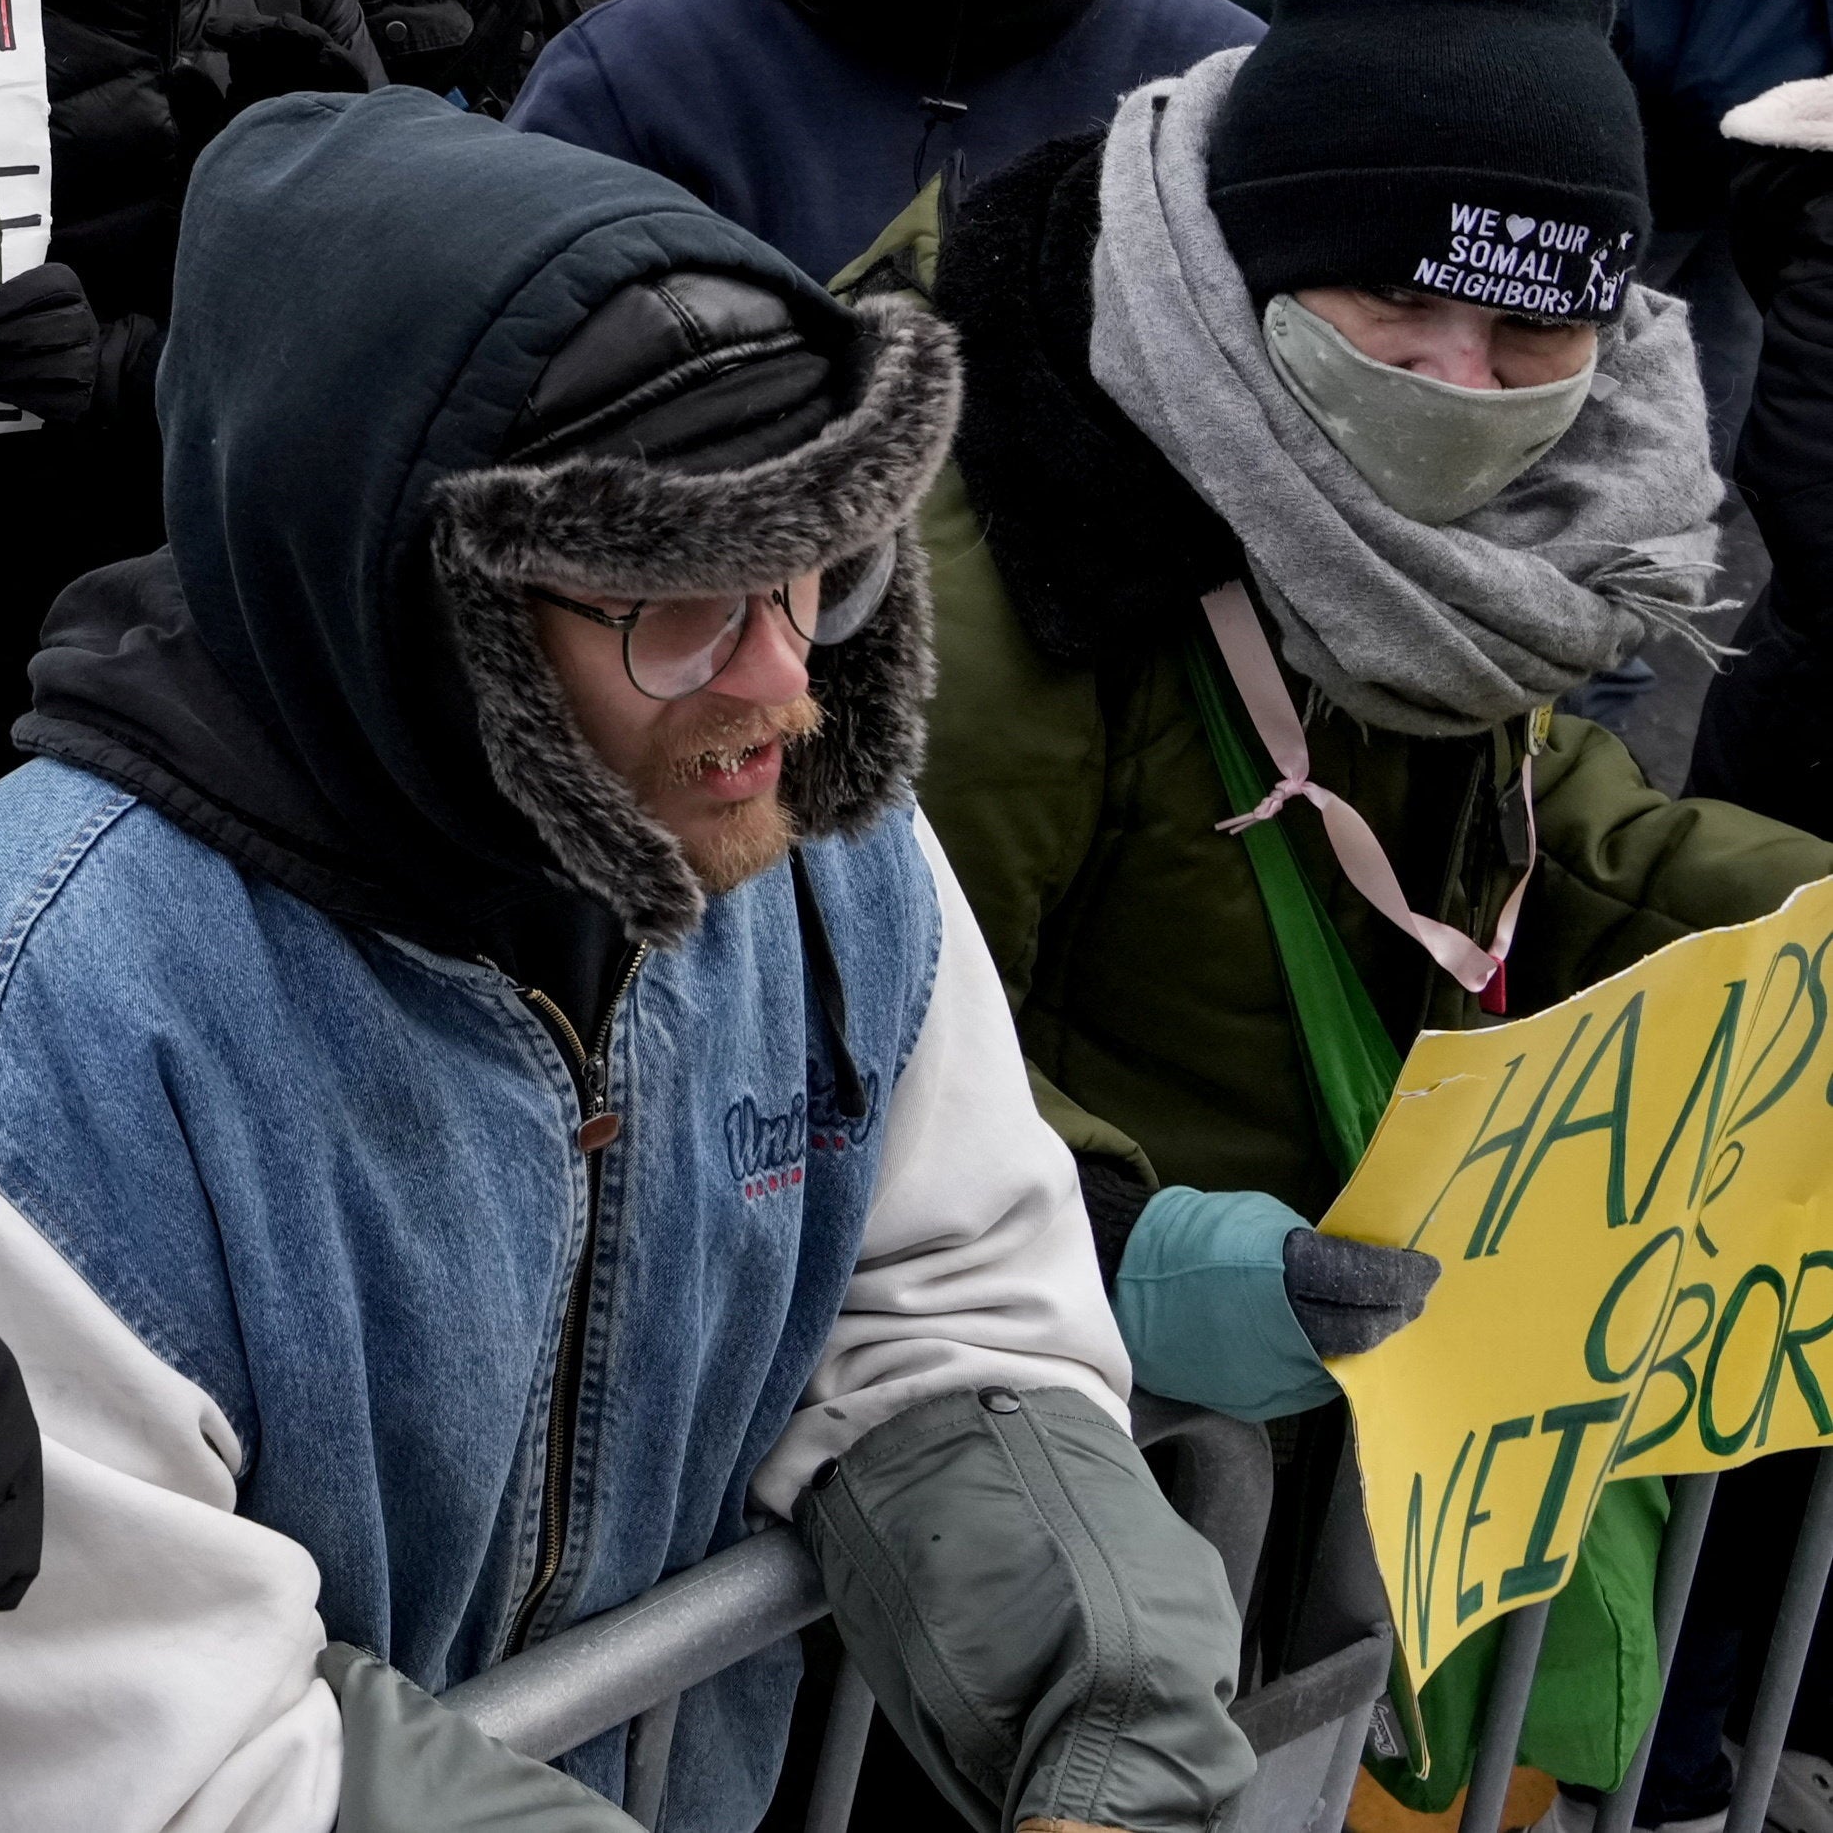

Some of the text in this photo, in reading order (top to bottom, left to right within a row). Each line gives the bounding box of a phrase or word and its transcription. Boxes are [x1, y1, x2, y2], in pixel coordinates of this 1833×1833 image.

[1450, 202, 1590, 254] WE OUR
[1449, 235, 1562, 284] SOMALI
[1413, 257, 1573, 315] NEIGHBORS
